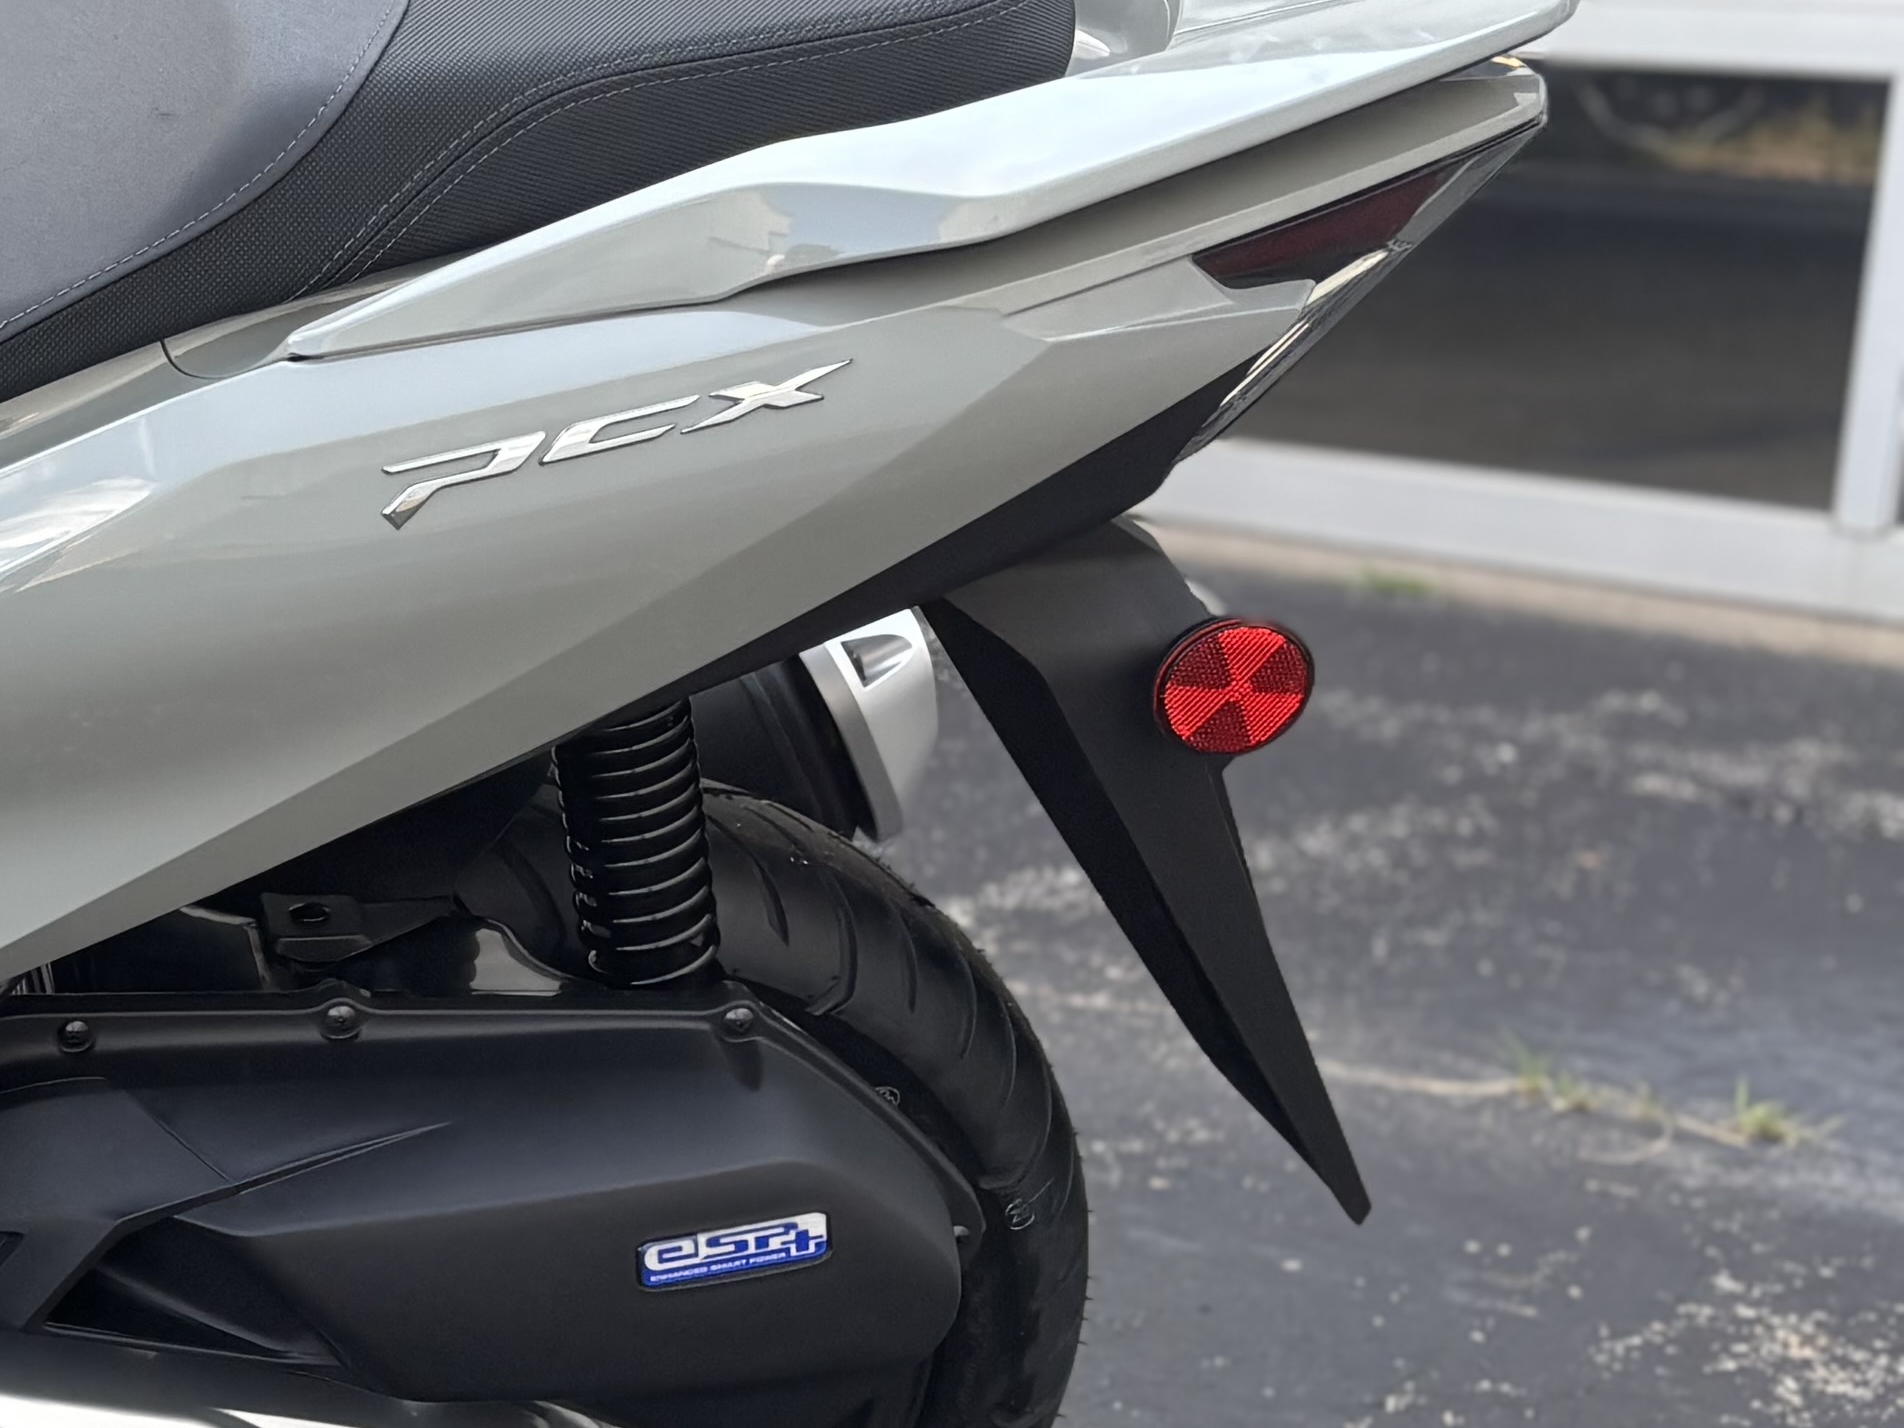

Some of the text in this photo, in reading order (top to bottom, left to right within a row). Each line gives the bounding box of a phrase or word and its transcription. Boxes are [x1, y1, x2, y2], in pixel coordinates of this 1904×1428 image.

[380, 357, 854, 530] PCX
[650, 1251, 786, 1283] ENHANCED SMART POWER
